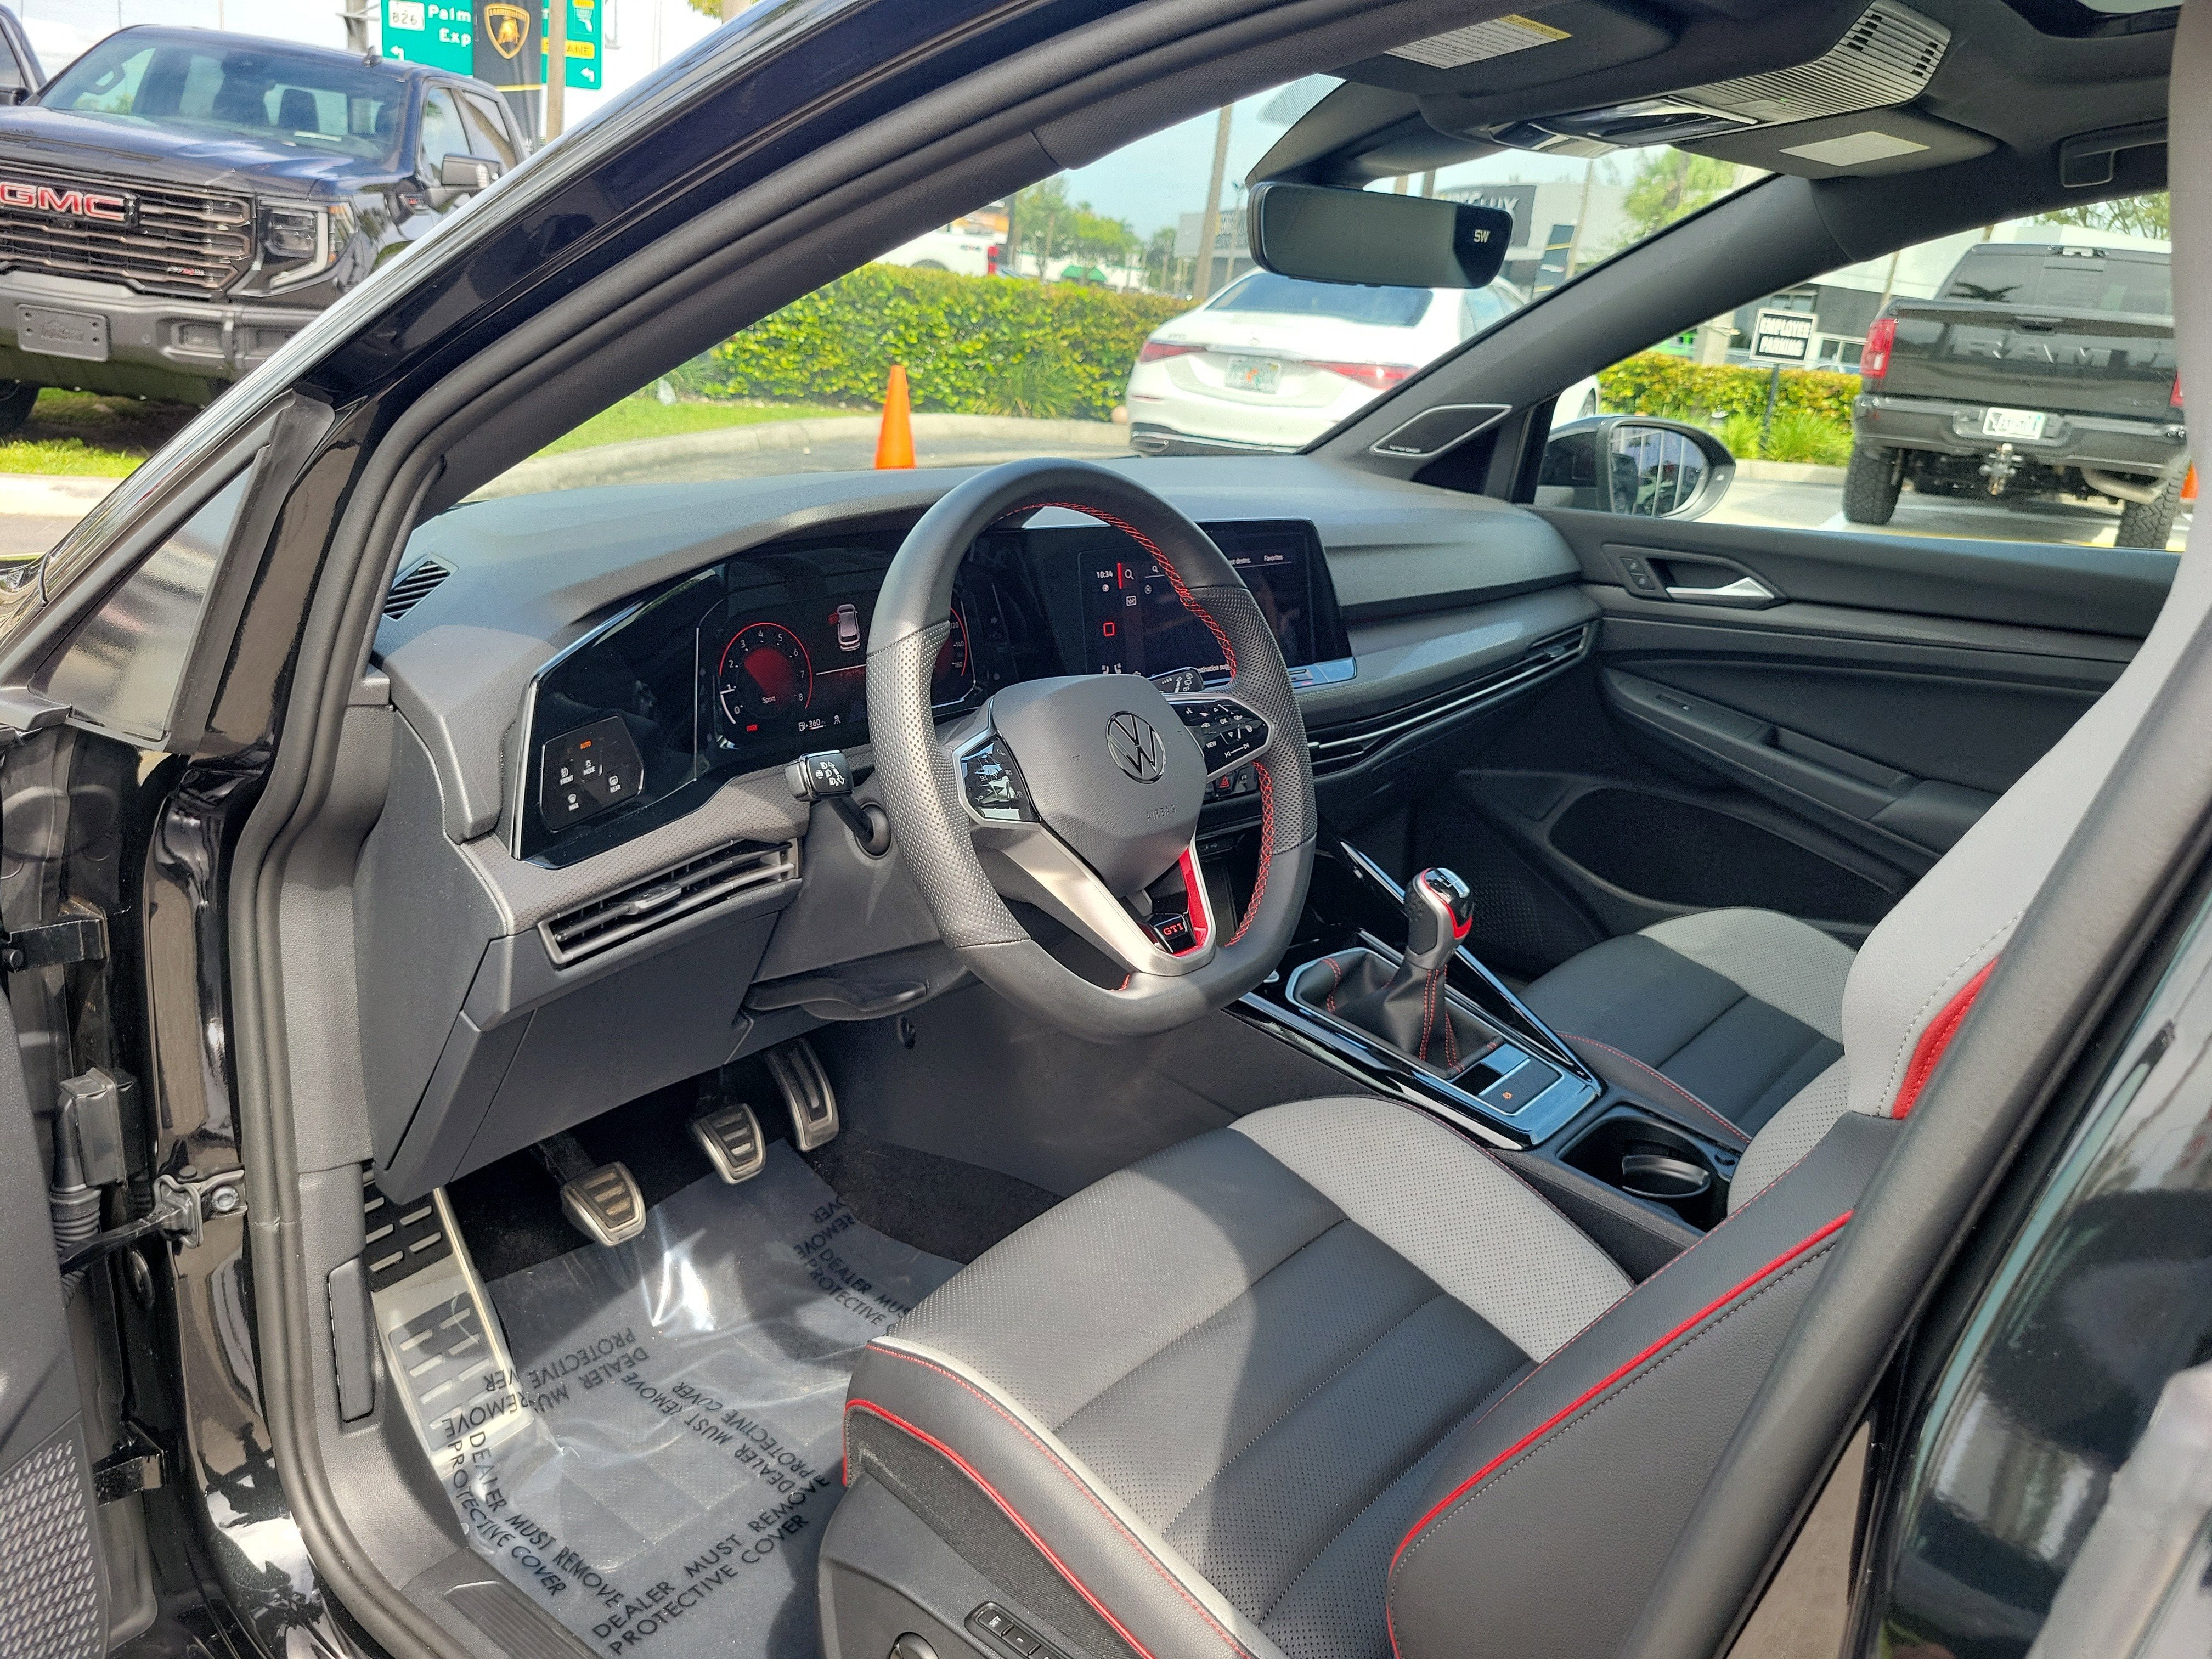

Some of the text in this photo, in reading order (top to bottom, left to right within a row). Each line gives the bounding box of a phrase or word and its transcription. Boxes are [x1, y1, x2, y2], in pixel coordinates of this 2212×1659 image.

[392, 11, 417, 25] 826
[427, 4, 471, 23] Palm
[439, 27, 471, 48] Exp
[567, 44, 590, 57] ANE
[0, 181, 125, 221] GMC
[1474, 229, 1491, 243] SW
[1759, 317, 1811, 338] EMPLOYEE
[1759, 335, 1804, 357] PARKING
[1952, 337, 2112, 368] RAM
[1097, 570, 1114, 579] 10:34
[741, 640, 746, 648] 3
[778, 634, 783, 642] 5
[794, 648, 798, 657] 6
[729, 659, 734, 668] 2
[800, 670, 804, 679] 7
[761, 696, 776, 704] Sport
[798, 693, 804, 701] 8
[734, 706, 740, 714] 0
[809, 719, 821, 727] 360
[560, 775, 574, 785] FRONT
[610, 784, 621, 793] REAR
[568, 802, 579, 811] MAX
[1163, 923, 1183, 935] GTI
[819, 1248, 872, 1295] DEALER
[804, 1257, 887, 1325] PROTECTIVE
[528, 1327, 636, 1390] PROTECTIVE
[579, 1346, 650, 1390] DEALER
[621, 1372, 795, 1493] DEALER MUST REMOVE
[672, 1381, 819, 1479] PROTECTIVE COVER
[448, 1441, 567, 1595] PROTECTIVE COVER
[469, 1431, 624, 1609] DEALER MUST REMOVE
[592, 1476, 831, 1638] DEALER MUST REMOVE
[609, 1514, 809, 1655] PROTECTIVE COVER
[988, 1615, 1002, 1627] SET
